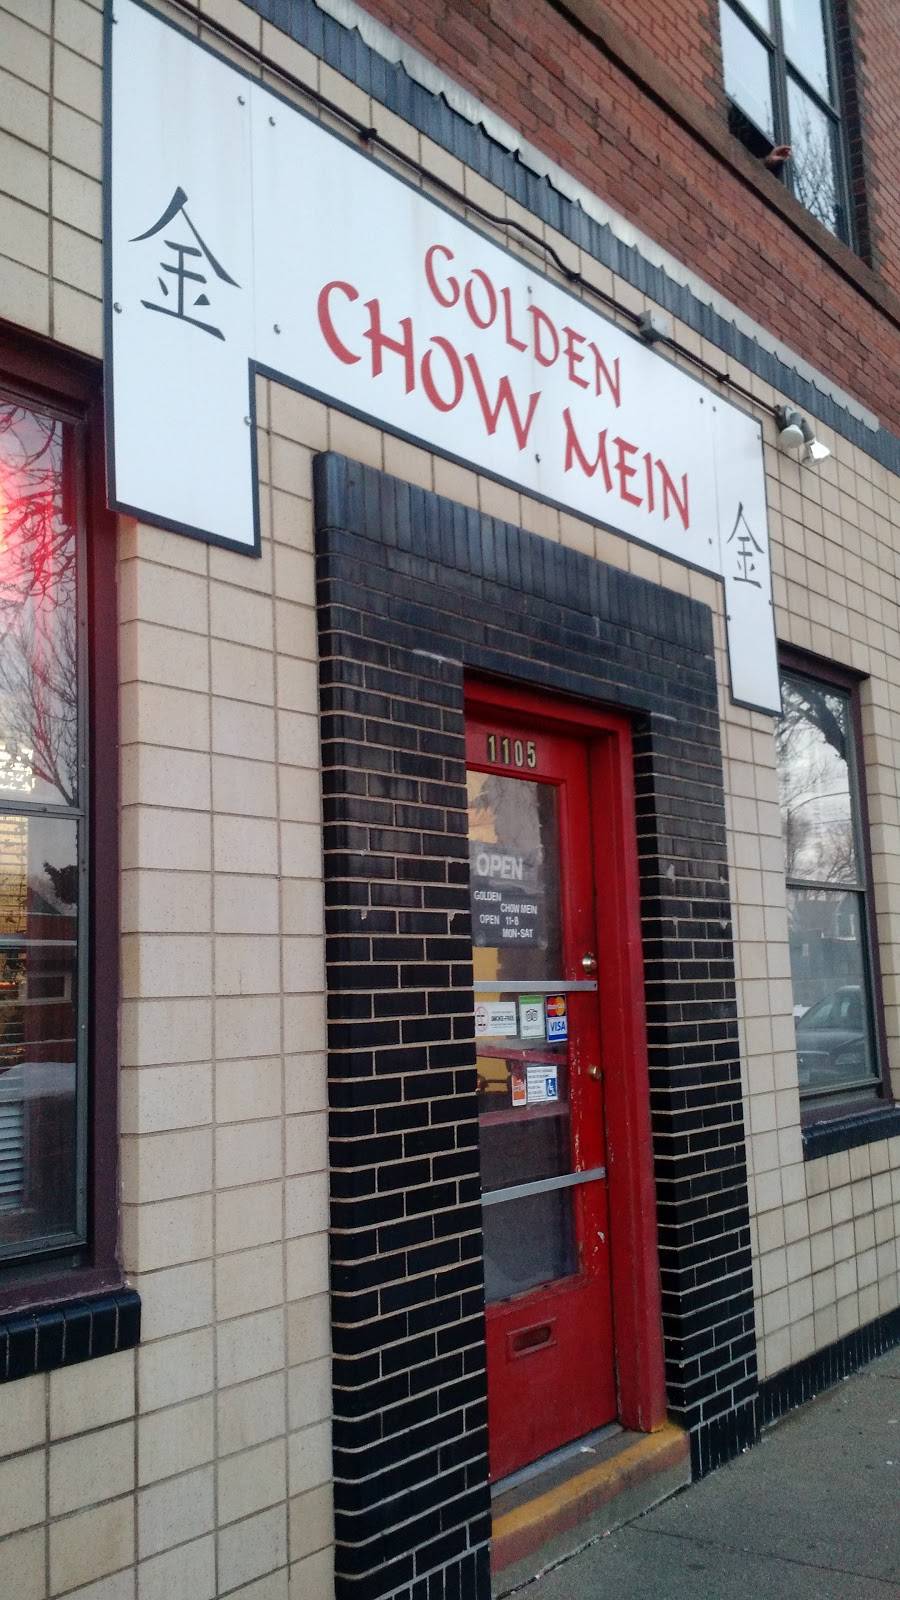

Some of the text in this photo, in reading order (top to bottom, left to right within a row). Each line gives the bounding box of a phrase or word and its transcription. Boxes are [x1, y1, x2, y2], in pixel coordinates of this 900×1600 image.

[128, 186, 243, 341] 金
[424, 244, 620, 408] GOLDEN
[317, 280, 690, 531] CHOW MEIN
[726, 501, 765, 589] 金
[487, 734, 537, 769] 1105
[476, 853, 523, 880] OPEN
[473, 890, 502, 901] GOLDEN
[500, 903, 538, 915] CHOW MEIN
[479, 914, 500, 925] OPEN
[550, 1020, 566, 1032] VISA
